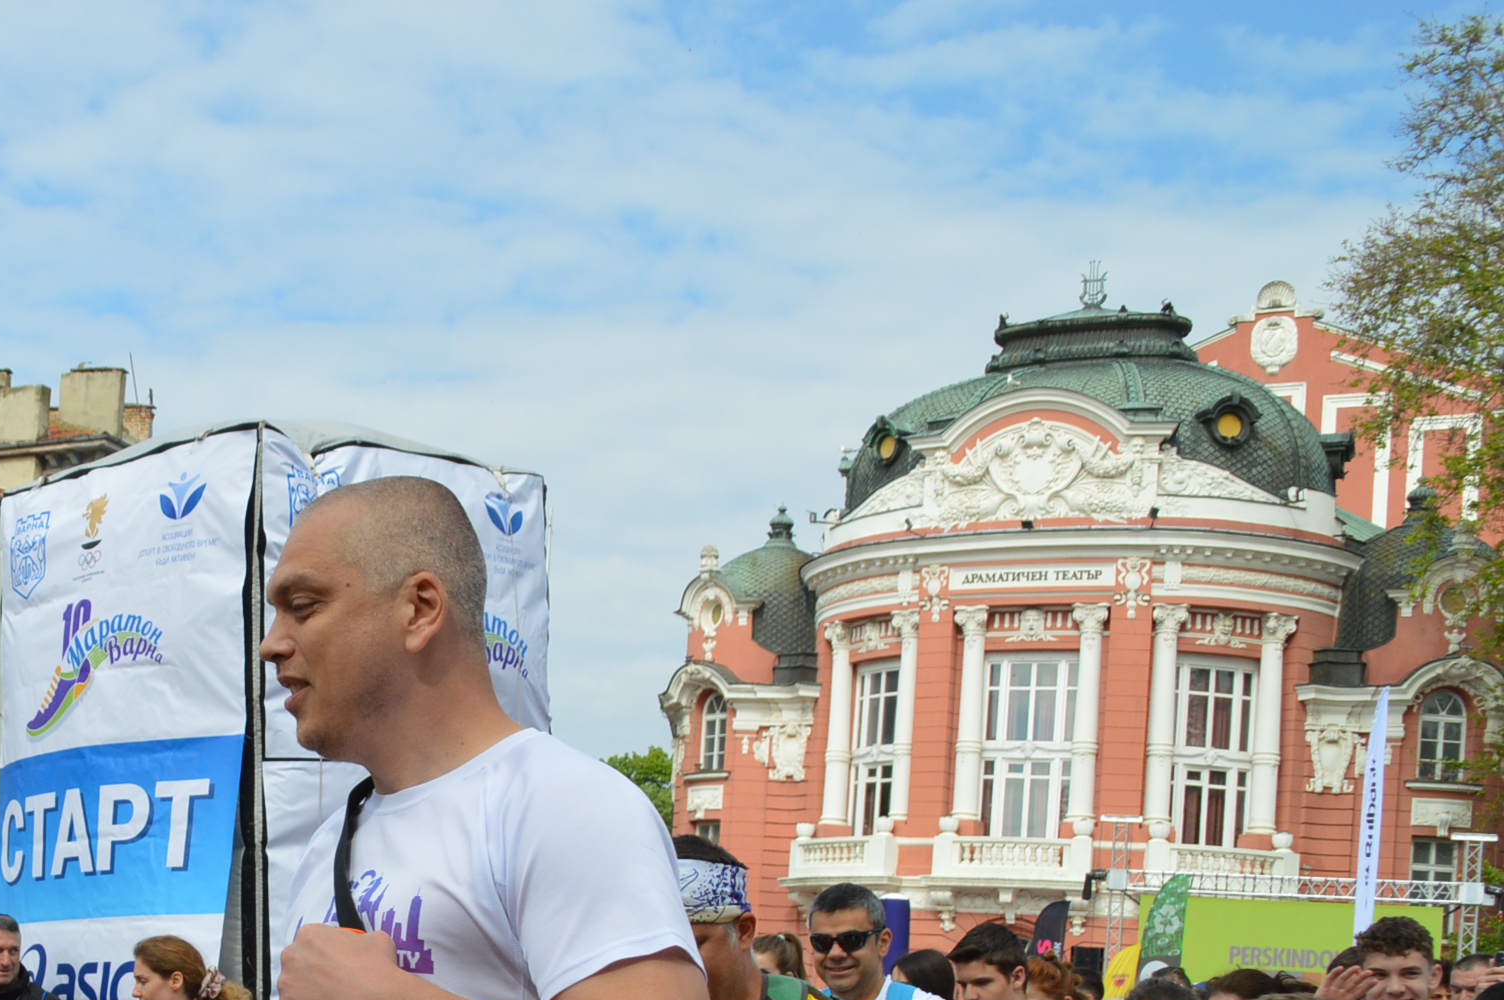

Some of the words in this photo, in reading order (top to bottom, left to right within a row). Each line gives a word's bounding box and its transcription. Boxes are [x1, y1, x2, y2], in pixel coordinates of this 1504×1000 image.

[962, 571, 1048, 584] ДРАМАТИЧЕН
[1054, 570, 1102, 581] ТЕАТЪР
[67, 613, 163, 672] Маратон
[104, 635, 165, 664] Варна
[0, 778, 212, 884] СТАРТ
[397, 950, 421, 969] TY
